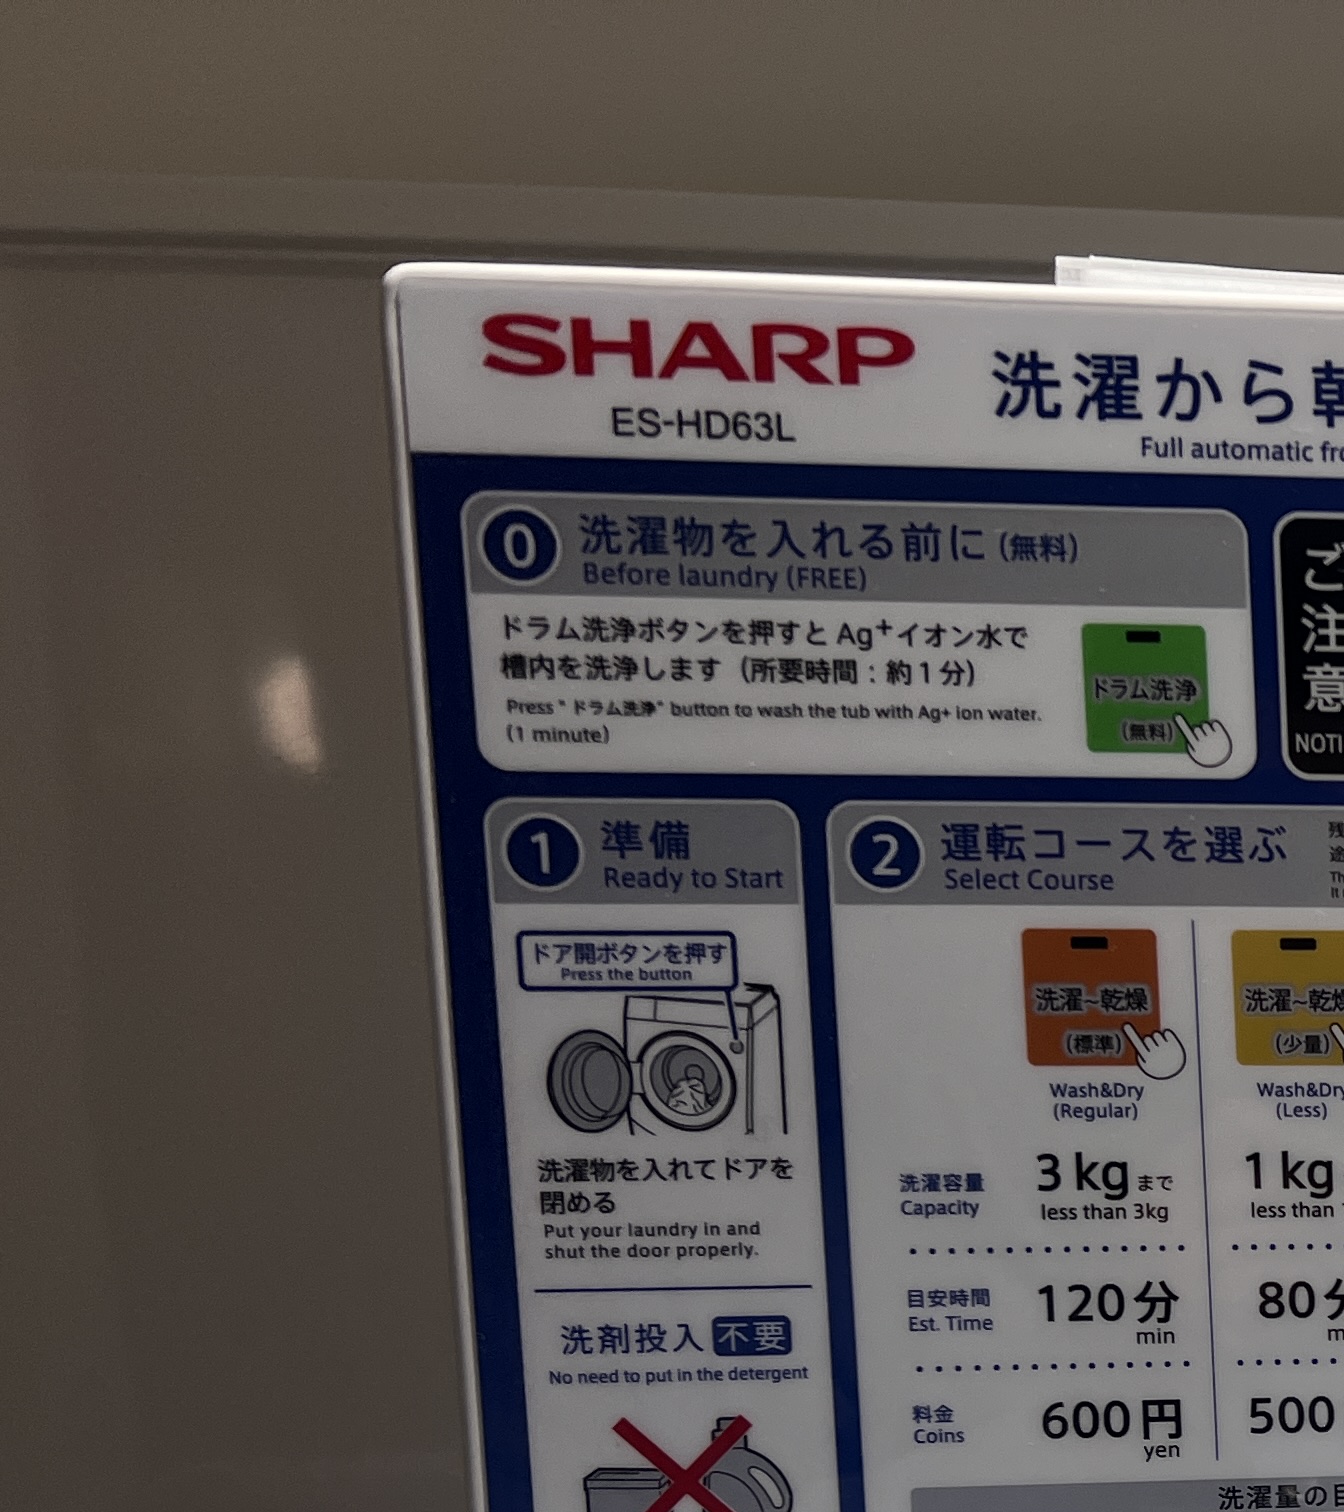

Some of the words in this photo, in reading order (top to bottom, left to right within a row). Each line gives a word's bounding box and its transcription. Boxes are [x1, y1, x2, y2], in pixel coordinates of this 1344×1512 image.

[482, 314, 914, 385] SHARP
[612, 407, 795, 442] ES-HD63L
[1141, 436, 1182, 458] Full
[1191, 441, 1313, 461] automatic
[504, 524, 536, 568] 0
[579, 514, 984, 562] 洗濯物を入れる前に
[582, 562, 670, 585] Before
[678, 564, 778, 592] laundry
[786, 565, 866, 591] (FREE)
[531, 832, 549, 873] 1
[601, 820, 691, 860] 準備
[873, 834, 900, 875] 2
[941, 823, 1286, 863] 運転コースを選ぶ
[604, 867, 683, 891] Ready
[690, 869, 717, 888] to
[724, 867, 783, 888] Start
[944, 868, 1020, 889] Select
[1027, 869, 1114, 890] Course
[900, 1172, 985, 1193] 洗濯容量
[901, 1200, 979, 1218] Capacity
[907, 1289, 991, 1308] 目安時間
[561, 1324, 704, 1354] 洗剤投入
[717, 1322, 785, 1351] 不要
[913, 1408, 954, 1424] 料金
[914, 1429, 964, 1443] Coins
